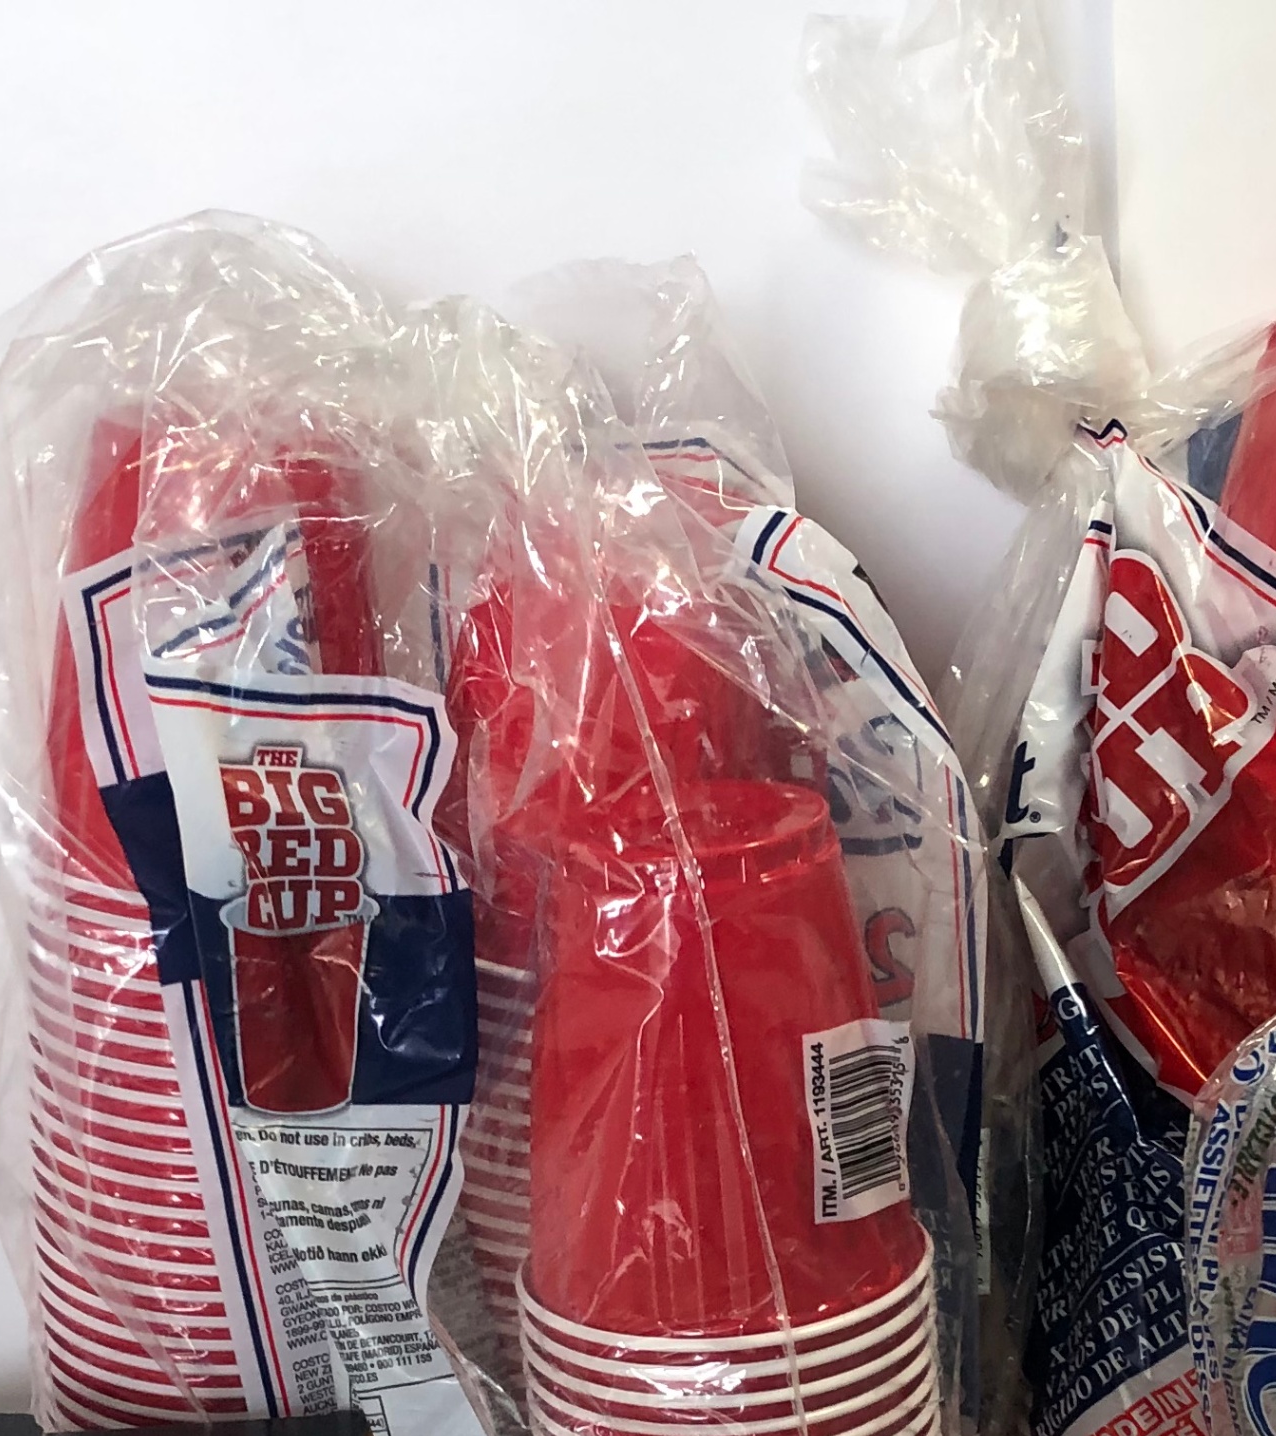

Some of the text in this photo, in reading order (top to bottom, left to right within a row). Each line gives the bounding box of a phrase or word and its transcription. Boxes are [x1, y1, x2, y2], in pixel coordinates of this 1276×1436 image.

[1251, 705, 1270, 724] TM
[257, 750, 298, 768] THE
[222, 767, 344, 828] BIG
[233, 827, 363, 880] RED
[810, 1041, 827, 1117] 1193444
[259, 1130, 277, 1142] Do
[280, 1131, 300, 1145] not
[304, 1133, 328, 1146] use
[333, 1132, 346, 1146] in
[350, 1133, 380, 1148] cribs,
[385, 1133, 417, 1148] beds,
[816, 1121, 834, 1163] ART.
[375, 1166, 398, 1178] pas
[821, 1178, 838, 1218] ITM.
[311, 1203, 352, 1217] camas,
[328, 1248, 358, 1262] hann
[365, 1302, 401, 1314] COSTCO
[295, 1367, 320, 1382] NEW
[1156, 1384, 1192, 1416] IN
